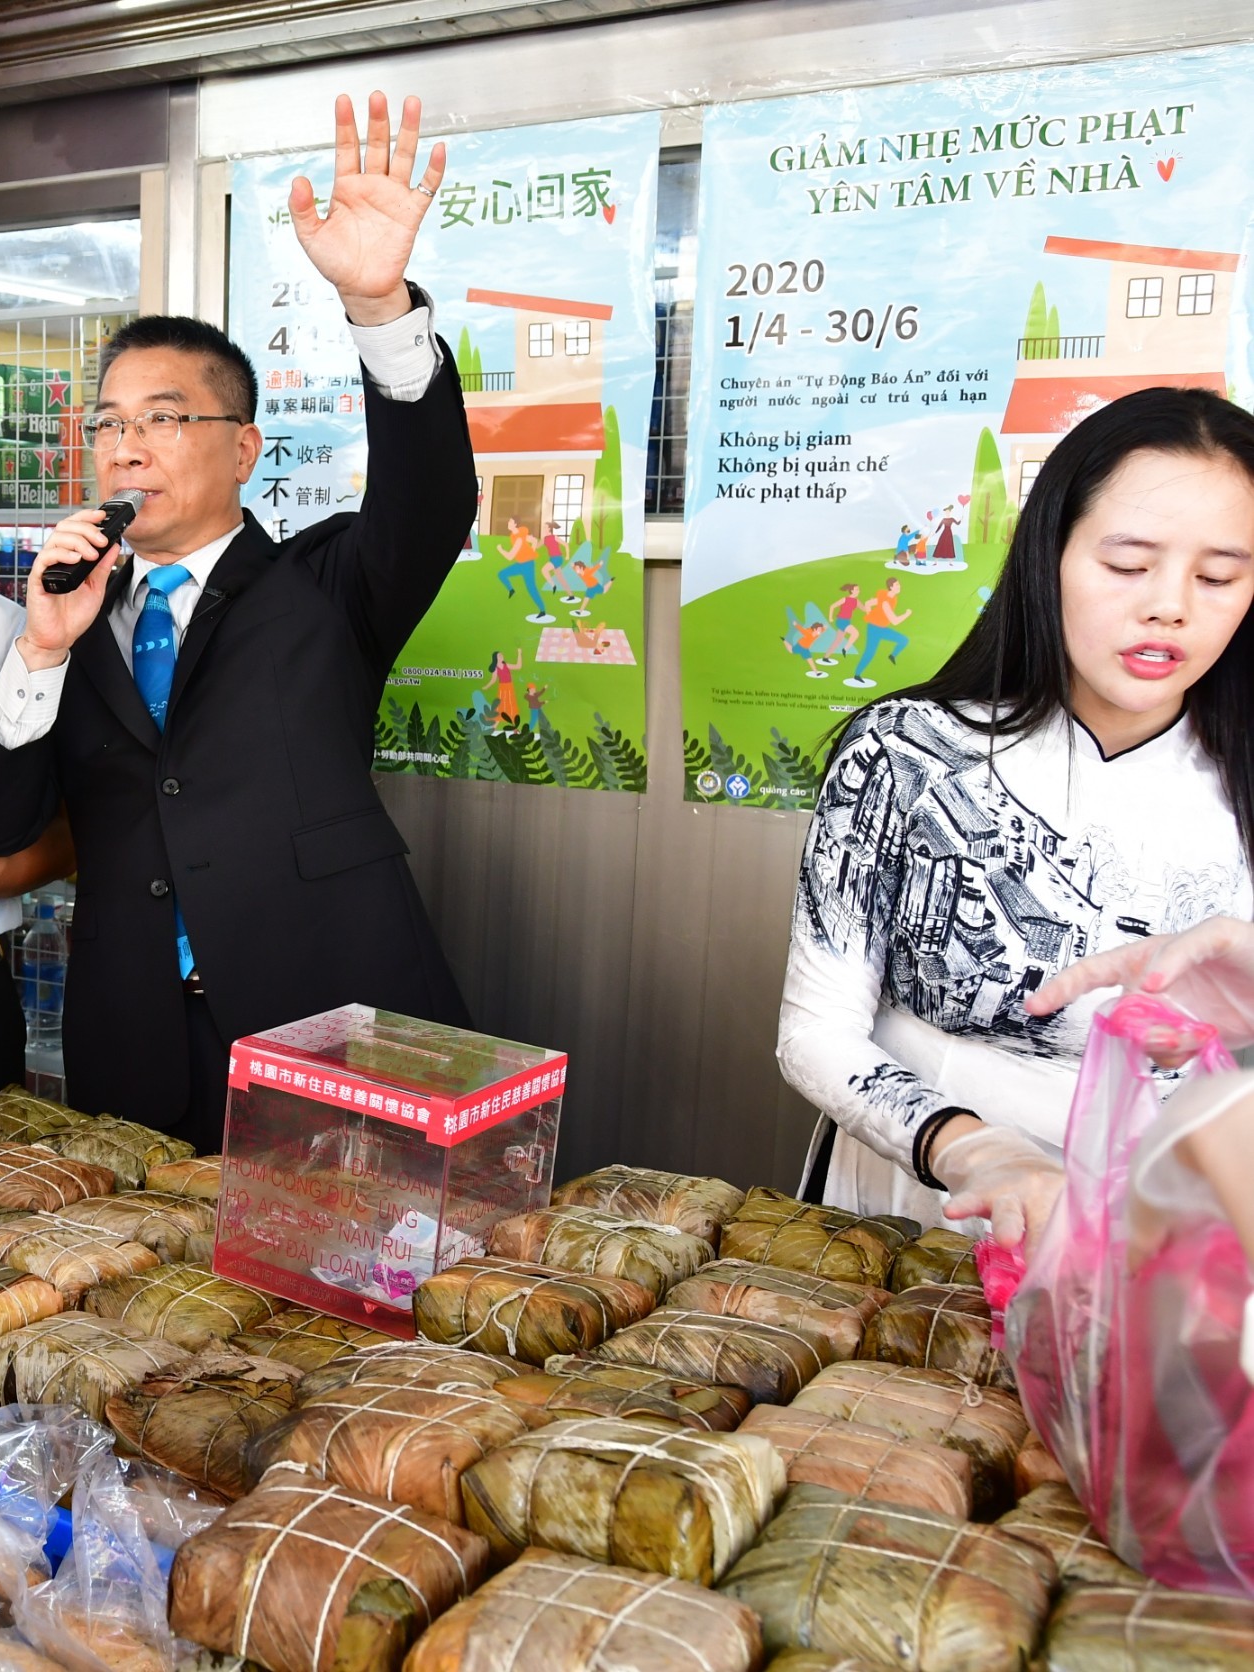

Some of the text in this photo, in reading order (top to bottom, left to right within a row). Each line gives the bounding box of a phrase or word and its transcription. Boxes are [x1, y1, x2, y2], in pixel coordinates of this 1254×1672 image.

[769, 103, 1194, 172] GIẢM NHẸ MỨC PHẠT
[439, 167, 612, 230] 安心回家
[806, 154, 1141, 215] YÊN TÂM VỀ NHÀ
[725, 258, 826, 298] 2020
[723, 310, 789, 354] 1/4
[825, 304, 919, 350] 30/6
[720, 377, 771, 392] Chuyên
[775, 377, 792, 388] án
[828, 374, 866, 390] Động
[871, 372, 898, 385] Báo
[936, 369, 961, 383] đối
[965, 369, 989, 382] với
[719, 389, 987, 411] người nước ngoài cư trú quá hạn
[718, 430, 852, 451] Không bị giam
[717, 454, 890, 478] Không bị quản chế
[715, 477, 847, 503] Mức phạt thấp
[249, 1059, 430, 1125] 桃園市新住民慈善關懷協會
[319, 1252, 368, 1282] LOAN
